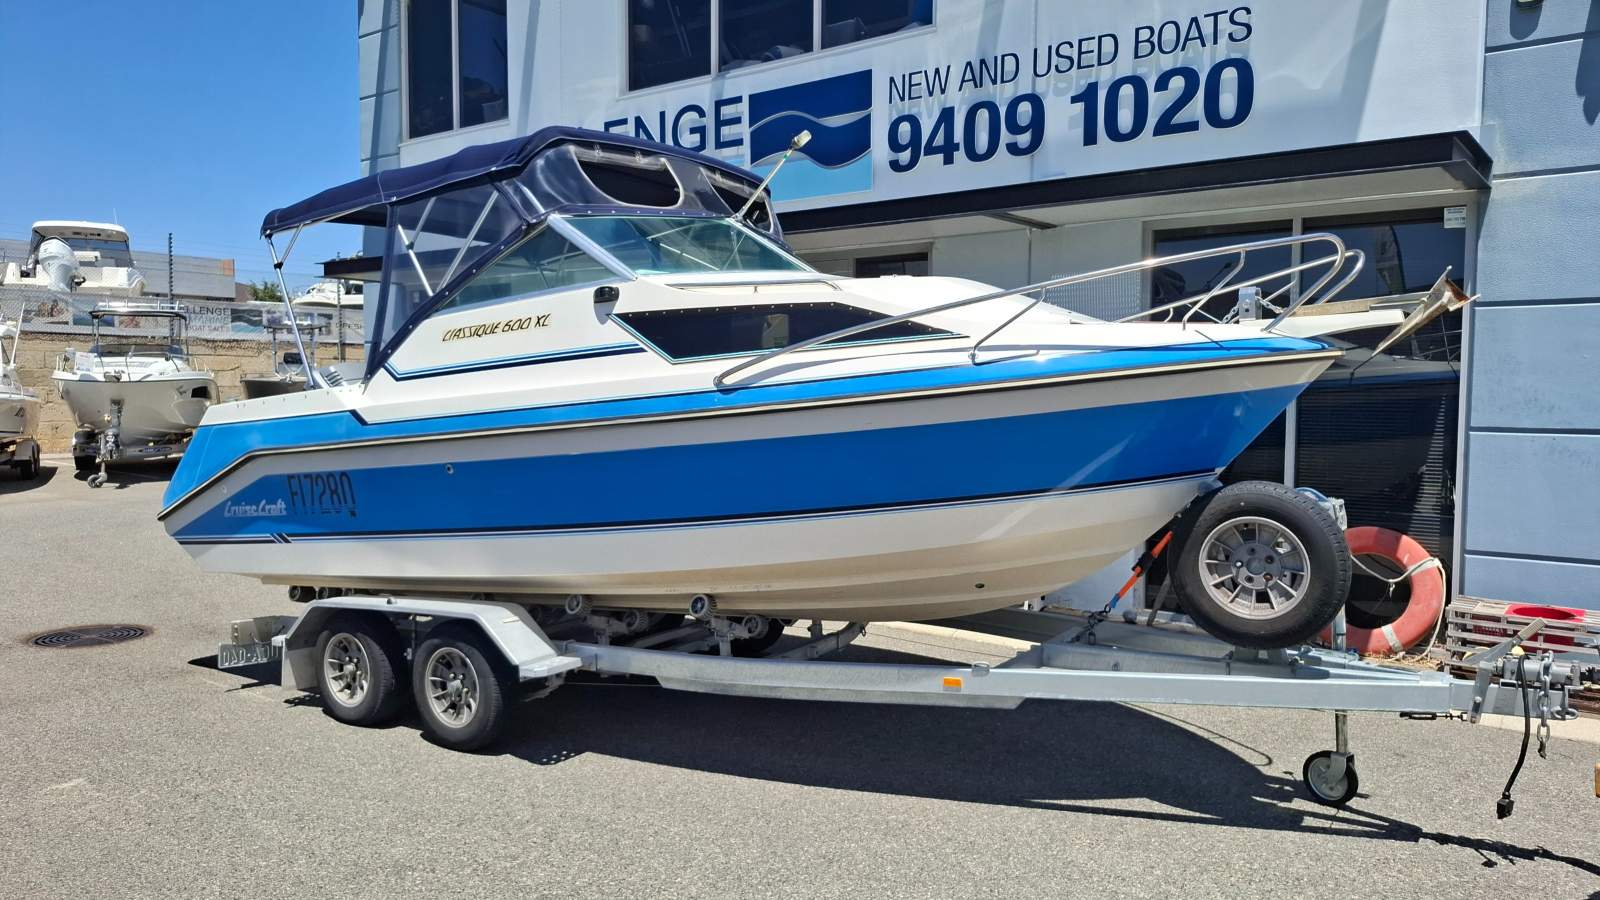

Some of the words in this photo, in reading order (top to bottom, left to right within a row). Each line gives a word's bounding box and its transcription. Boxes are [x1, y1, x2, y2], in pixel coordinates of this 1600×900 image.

[888, 64, 952, 105] NEW
[957, 52, 1020, 92] AND
[1032, 33, 1120, 79] USED
[1133, 6, 1253, 60] BOATS
[887, 93, 1046, 173] 9409
[1070, 57, 1255, 147] 1020
[502, 317, 532, 333] 600
[535, 313, 551, 328] XL
[224, 500, 258, 517] Cruise
[258, 498, 287, 516] Craft
